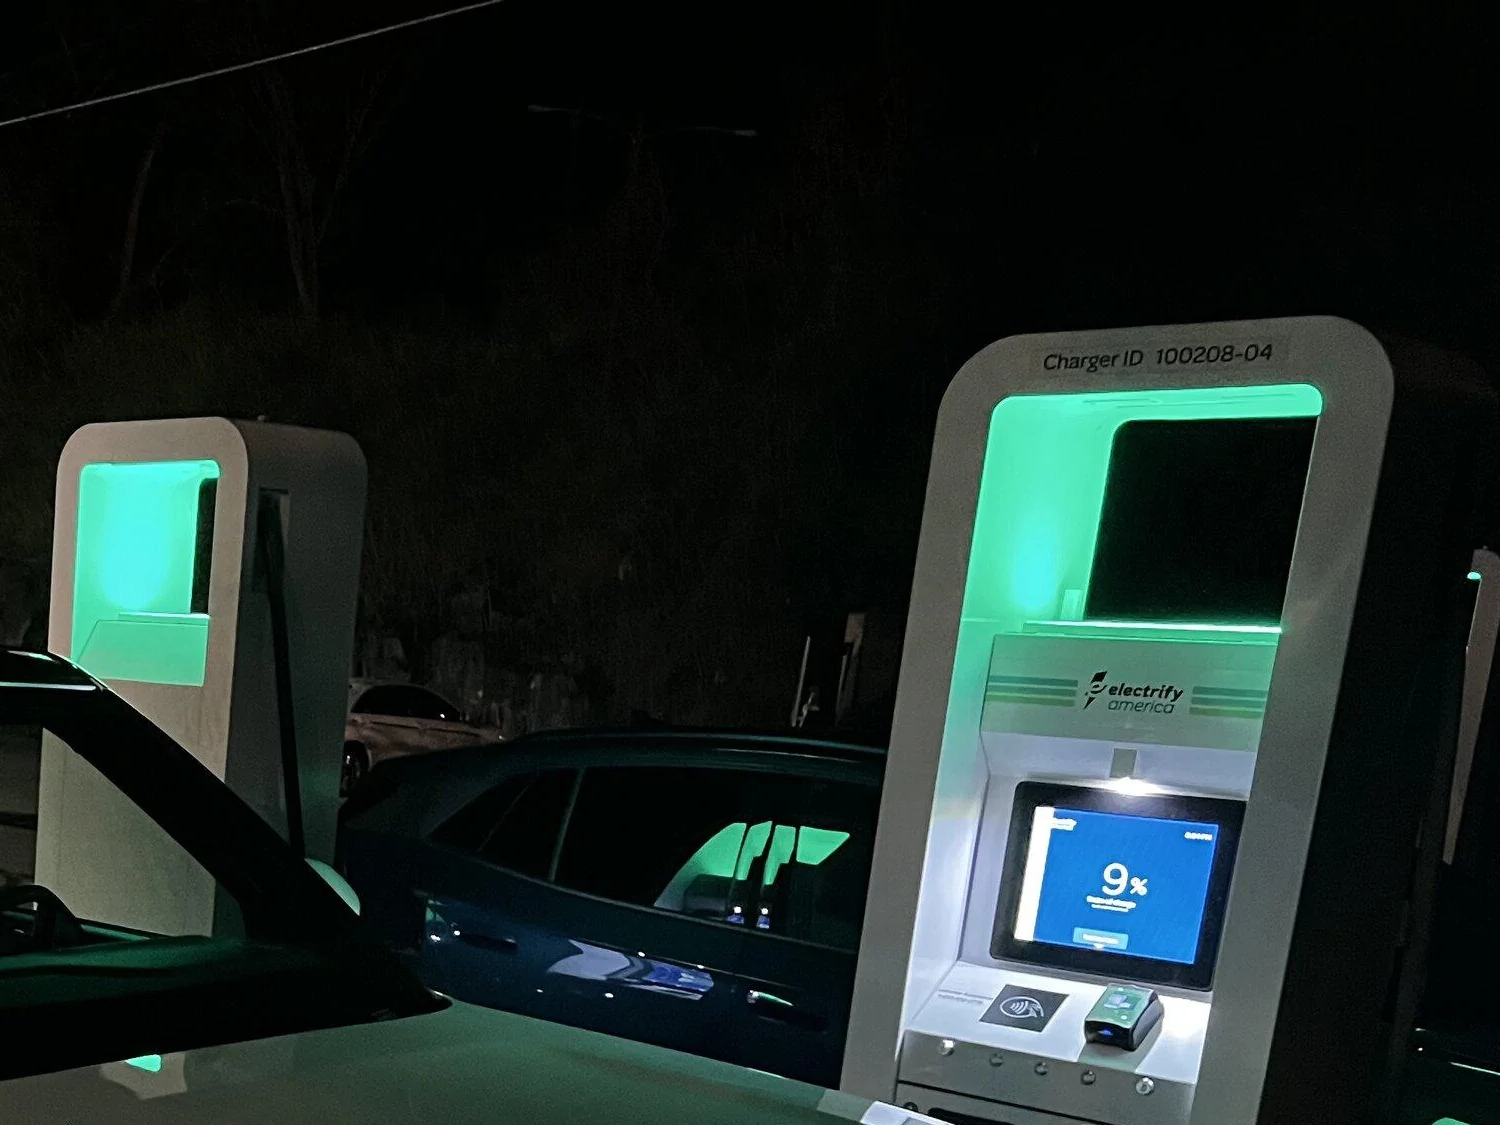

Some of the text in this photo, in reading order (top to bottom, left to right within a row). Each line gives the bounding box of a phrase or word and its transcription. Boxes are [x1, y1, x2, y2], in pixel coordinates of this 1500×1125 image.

[1043, 343, 1274, 373] Charger ID 100208-04
[1108, 682, 1184, 703] electrify
[1107, 699, 1175, 714] america
[1101, 862, 1149, 896] 9%
